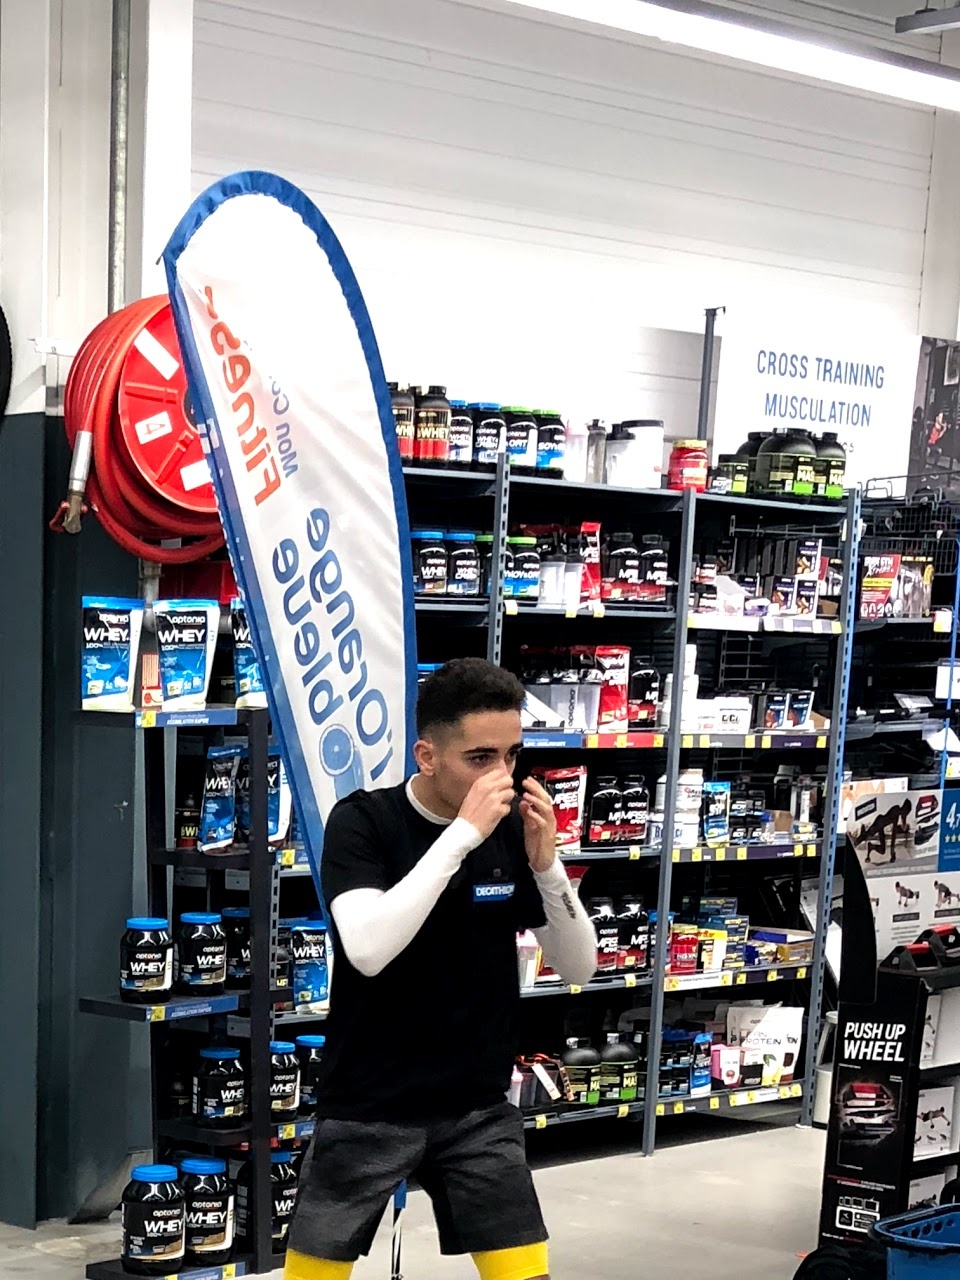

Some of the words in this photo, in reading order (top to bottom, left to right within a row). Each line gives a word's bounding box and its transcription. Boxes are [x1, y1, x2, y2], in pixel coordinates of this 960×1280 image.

[757, 350, 809, 380] CROSS
[815, 357, 884, 389] TRAINING
[764, 393, 871, 427] MUSCULATION
[83, 627, 128, 641] WHEY
[157, 629, 205, 643] WHEY
[293, 946, 324, 958] WHEY
[130, 961, 164, 974] WHEY
[844, 1022, 883, 1040] PUSH
[885, 1023, 906, 1040] UP
[843, 1039, 905, 1062] WHEEL
[185, 1210, 227, 1224] WHEY
[144, 1219, 184, 1233] WHEY
